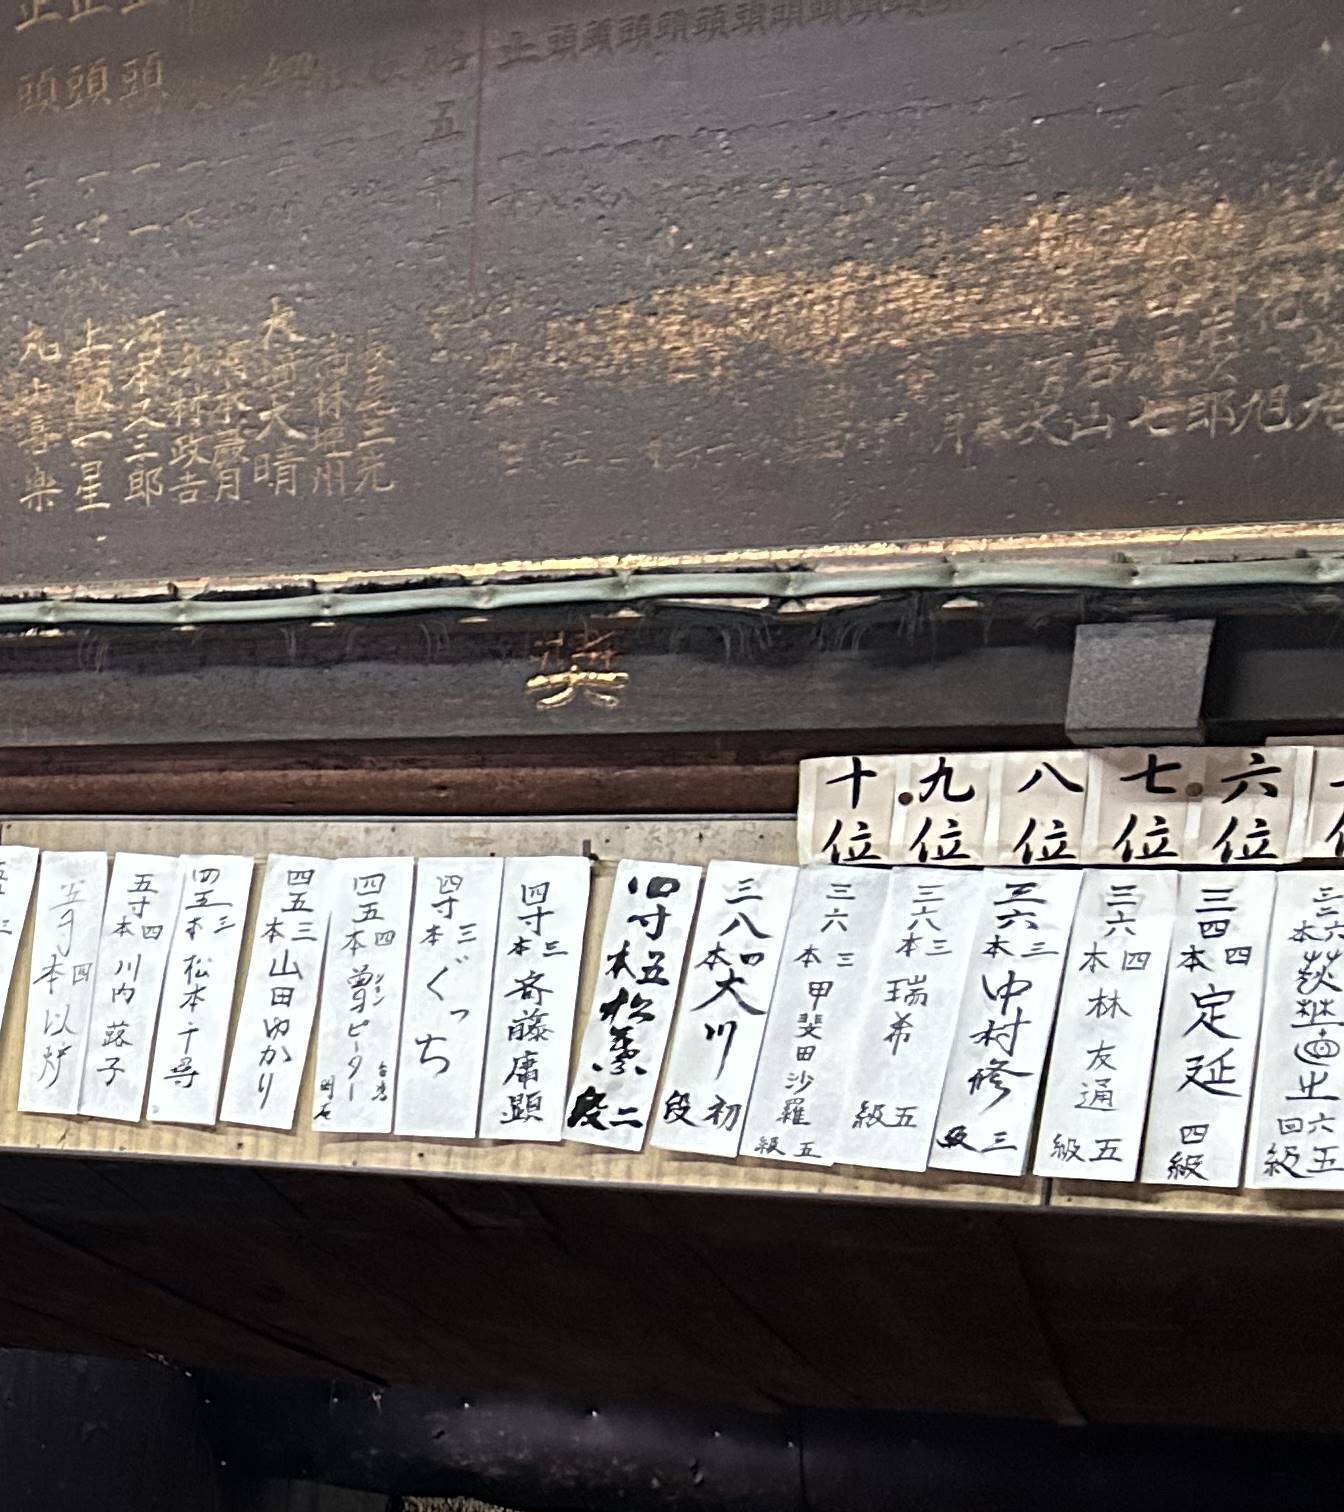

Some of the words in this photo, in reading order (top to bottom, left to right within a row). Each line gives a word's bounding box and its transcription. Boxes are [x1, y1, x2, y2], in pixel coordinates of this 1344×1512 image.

[821, 756, 878, 863] 十位
[909, 756, 975, 863] 九位
[1012, 761, 1085, 864] 八位
[1112, 754, 1182, 863] 七位
[1211, 752, 1282, 863] 六位
[690, 968, 768, 1081] 大川
[1166, 1124, 1210, 1181] 四級
